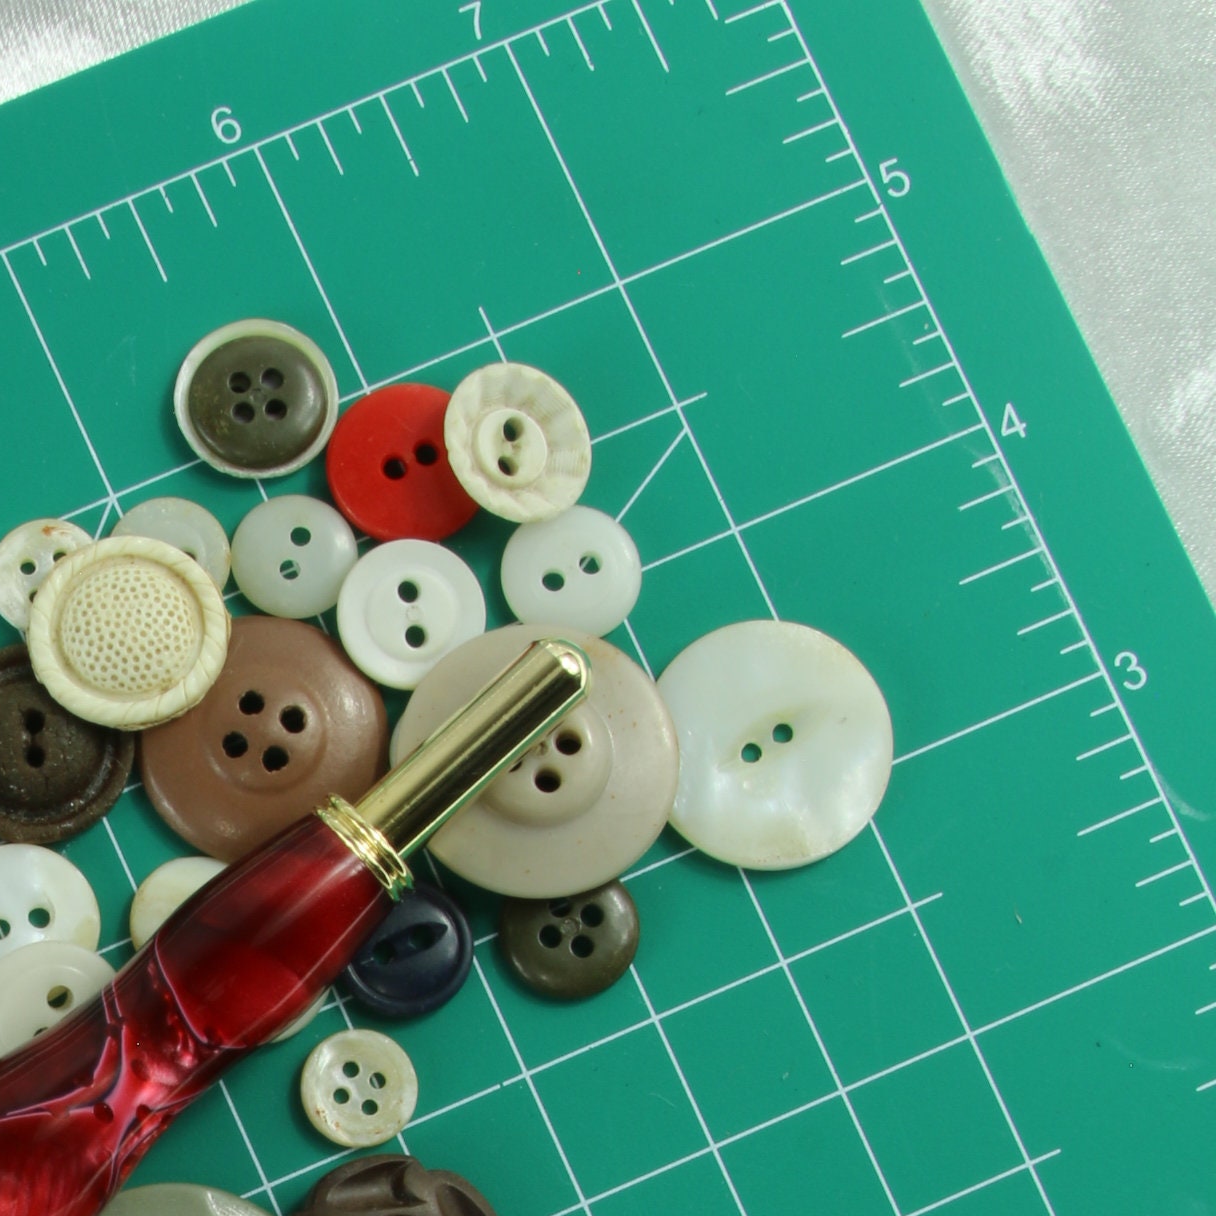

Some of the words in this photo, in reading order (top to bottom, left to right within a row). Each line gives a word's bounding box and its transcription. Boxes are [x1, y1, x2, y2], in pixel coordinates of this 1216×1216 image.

[457, 0, 483, 41] 7
[210, 104, 243, 145] 6
[878, 156, 912, 198] 5
[1000, 401, 1028, 439] 4
[1113, 649, 1149, 691] 3
